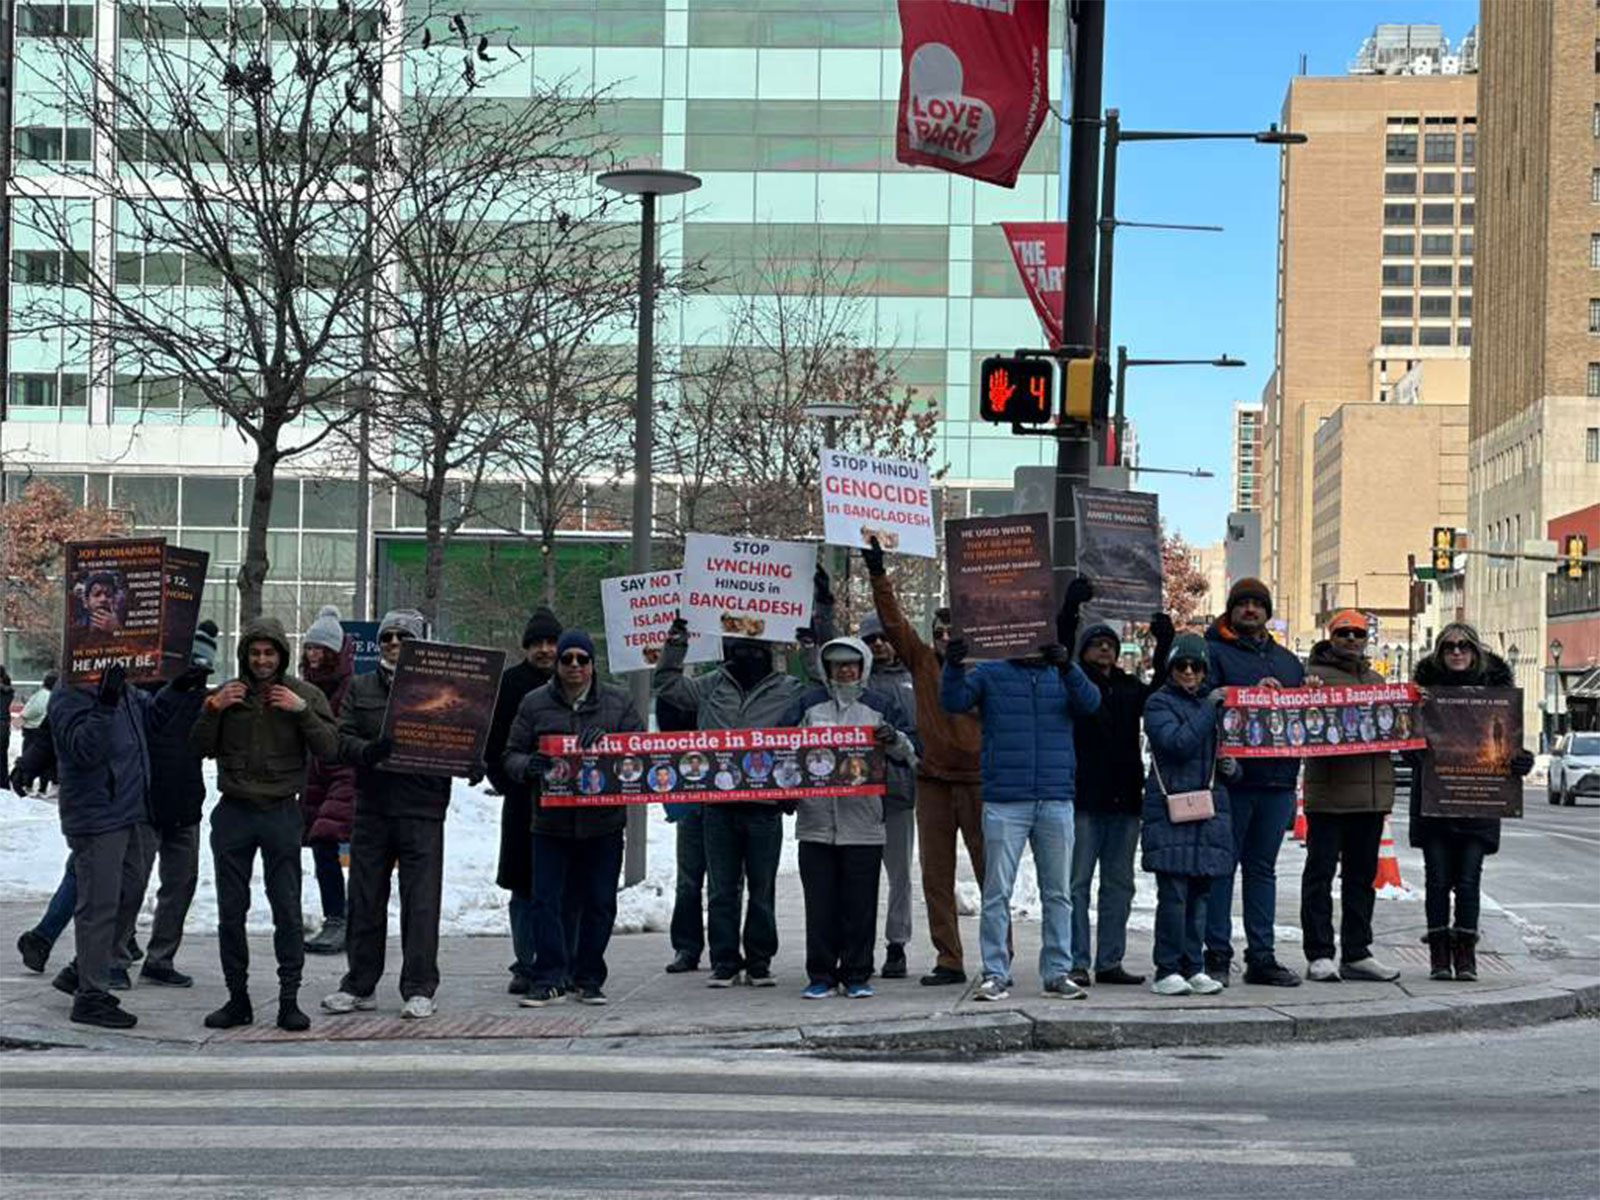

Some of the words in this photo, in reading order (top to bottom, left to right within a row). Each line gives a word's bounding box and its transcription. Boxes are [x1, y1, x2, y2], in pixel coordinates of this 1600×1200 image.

[914, 97, 983, 129] LOVE
[916, 119, 978, 155] PARK
[1013, 241, 1046, 266] THE
[1025, 266, 1065, 292] EAR
[1030, 376, 1045, 411] 4
[832, 455, 868, 471] STOP
[872, 461, 919, 480] HINDU
[826, 475, 929, 507] GENOCIDE
[827, 501, 840, 514] in
[843, 503, 931, 527] BANGLADESH
[961, 530, 973, 538] HE
[975, 528, 1000, 537] USED
[1001, 525, 1035, 535] WATER.
[78, 549, 97, 559] JOY
[99, 546, 161, 558] MOHAPATRA
[733, 541, 770, 555] STOP
[707, 557, 793, 579] LYNCHING
[174, 575, 188, 587] 12.
[620, 577, 646, 592] SAY
[650, 574, 671, 588] NO
[675, 572, 682, 585] T
[715, 577, 765, 593] HINDUS
[768, 582, 780, 594] in
[630, 592, 680, 609] RADICA
[689, 592, 803, 617] BANGLADESH
[633, 611, 675, 627] ISLAM
[624, 630, 676, 647] TERRO
[73, 658, 91, 672] HE
[93, 656, 132, 669] MUST
[135, 654, 156, 668] BE.
[1237, 689, 1271, 705] Hindu
[1272, 688, 1328, 706] Genocide
[1331, 687, 1343, 704] in
[1346, 685, 1409, 705] Bangladesh
[562, 736, 623, 753] Hdu
[628, 732, 720, 752] Genocide
[725, 731, 746, 748] in
[751, 727, 868, 750] Bangladesh
